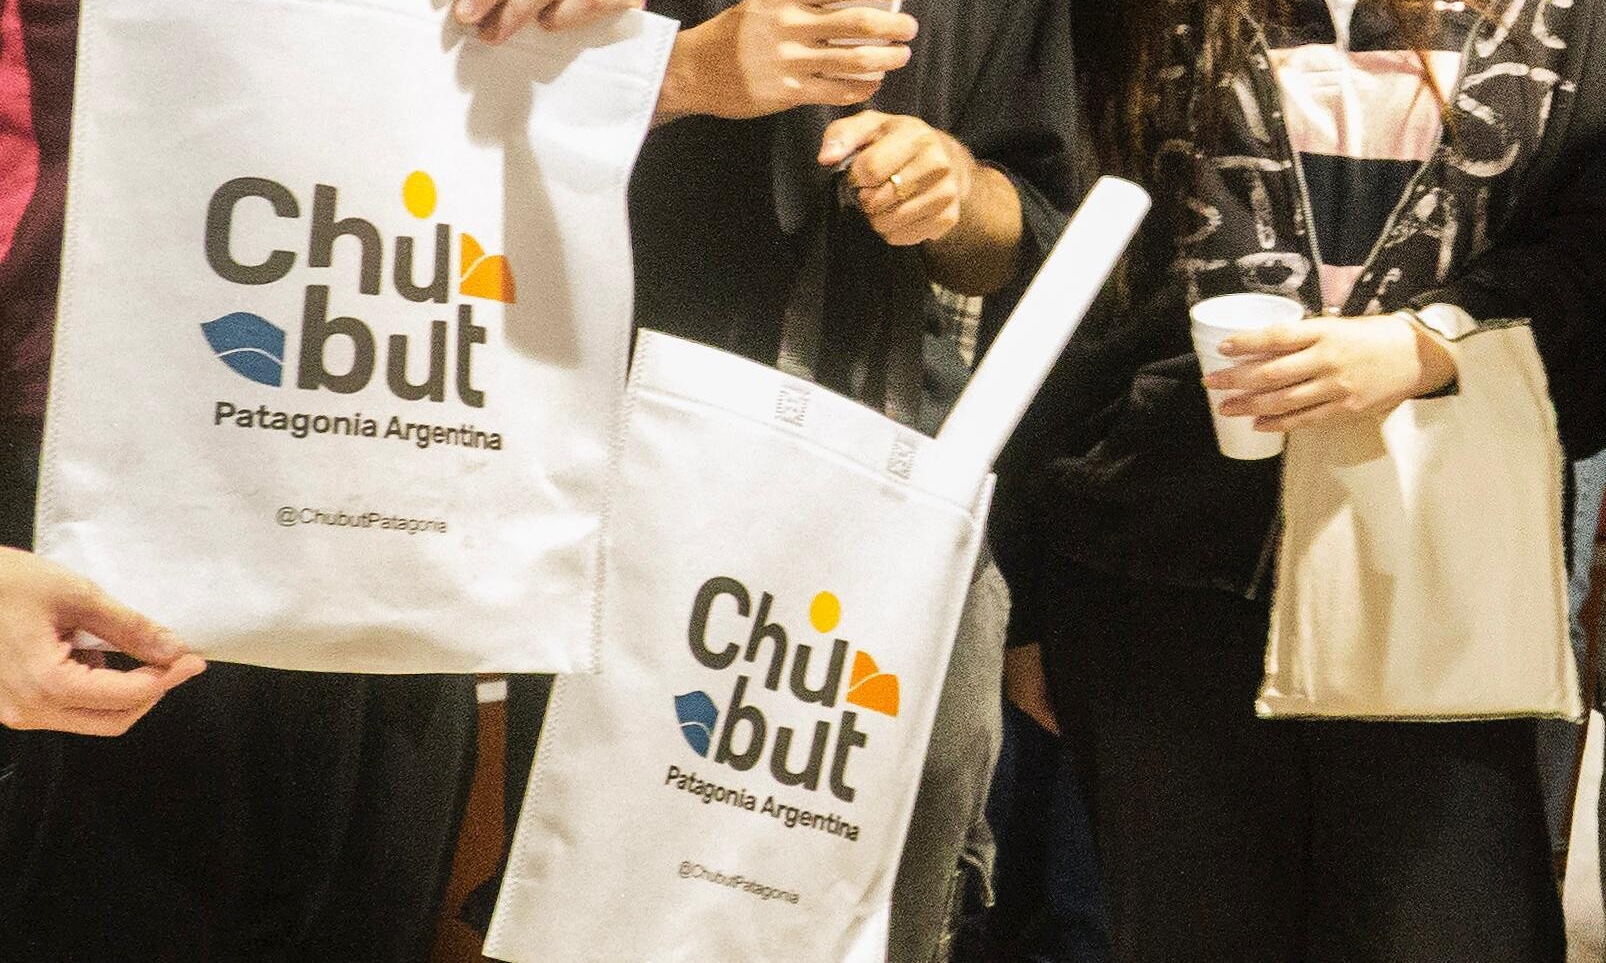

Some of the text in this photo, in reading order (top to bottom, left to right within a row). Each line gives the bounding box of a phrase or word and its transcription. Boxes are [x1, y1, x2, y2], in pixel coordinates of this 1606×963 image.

[296, 284, 487, 409] but
[213, 400, 503, 452] Patagonia Argentina
[275, 505, 448, 536] @ChubutPatagonia
[713, 675, 868, 804] but
[665, 764, 861, 842] Patagonia Argentina
